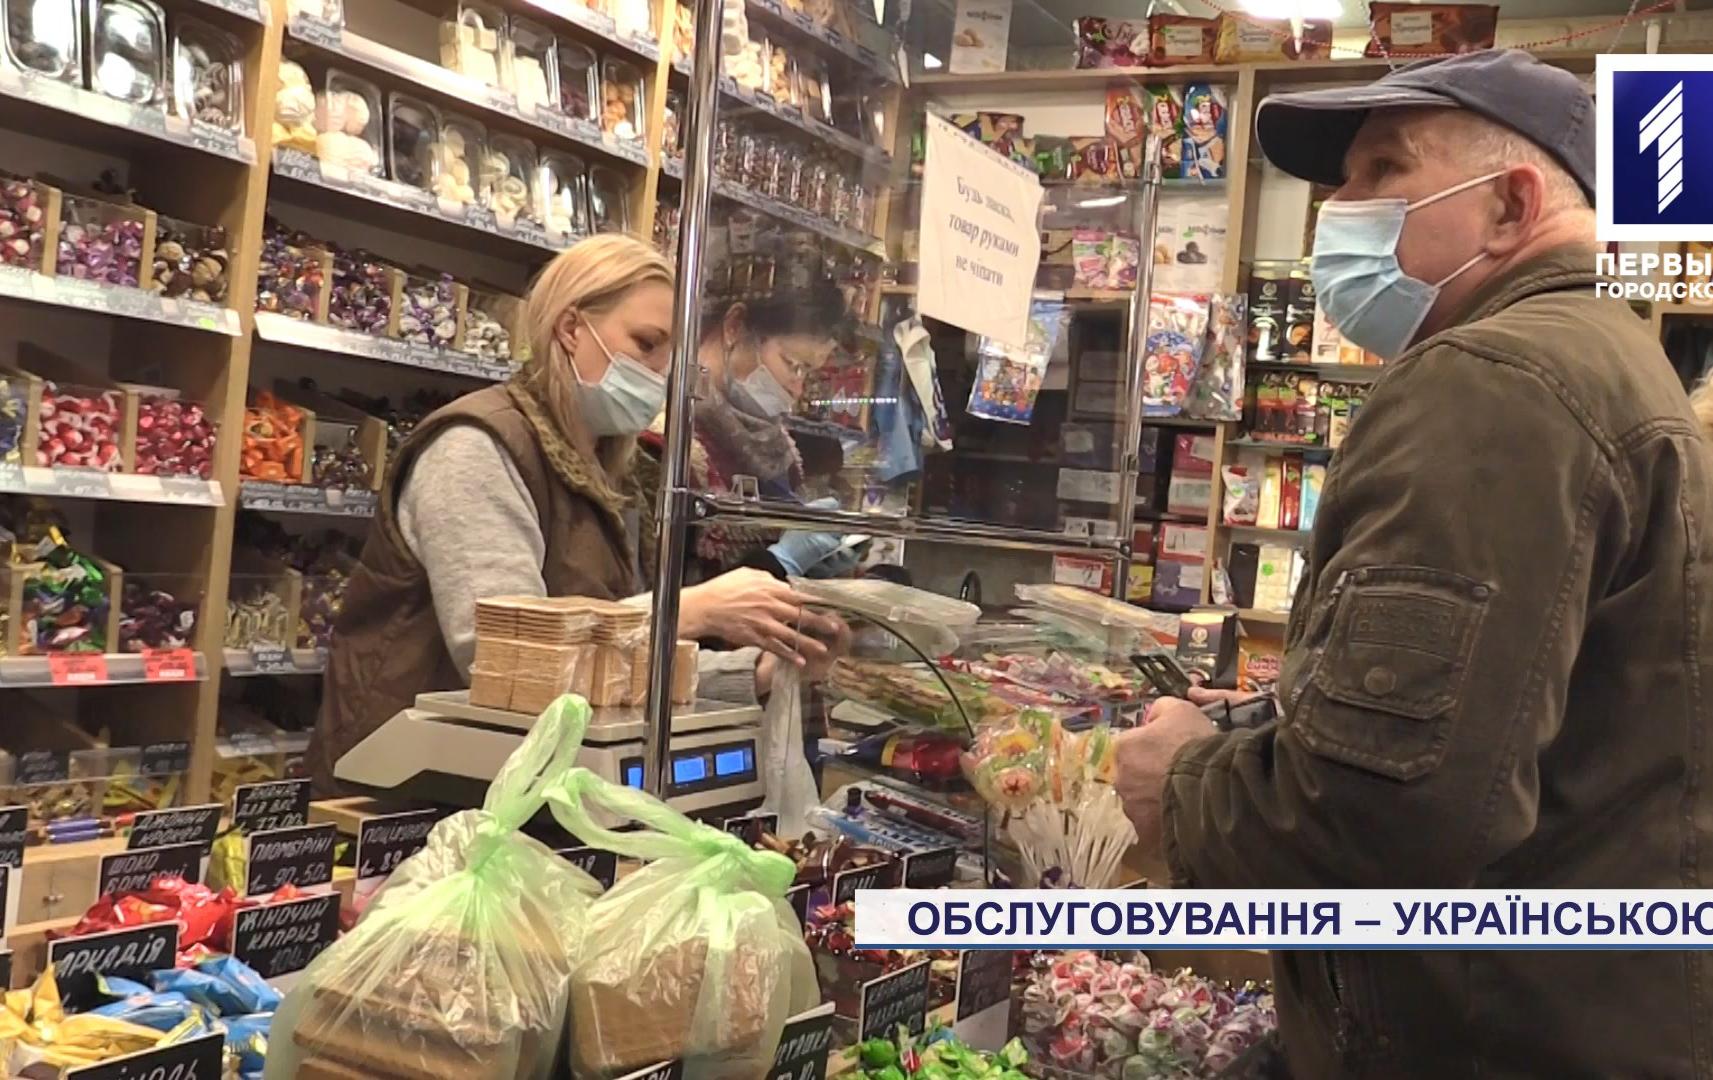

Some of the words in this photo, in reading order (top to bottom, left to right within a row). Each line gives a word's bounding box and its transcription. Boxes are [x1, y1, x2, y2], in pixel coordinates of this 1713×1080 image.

[957, 175, 983, 205] Будь
[948, 213, 980, 245] товар
[979, 226, 1020, 257] руками
[955, 254, 969, 272] не
[969, 260, 1004, 287] чіпати
[238, 897, 330, 932] ЖІНОЧИЙ
[246, 922, 321, 951] КАПРИЗ
[59, 933, 166, 977] АРКАДІЯ
